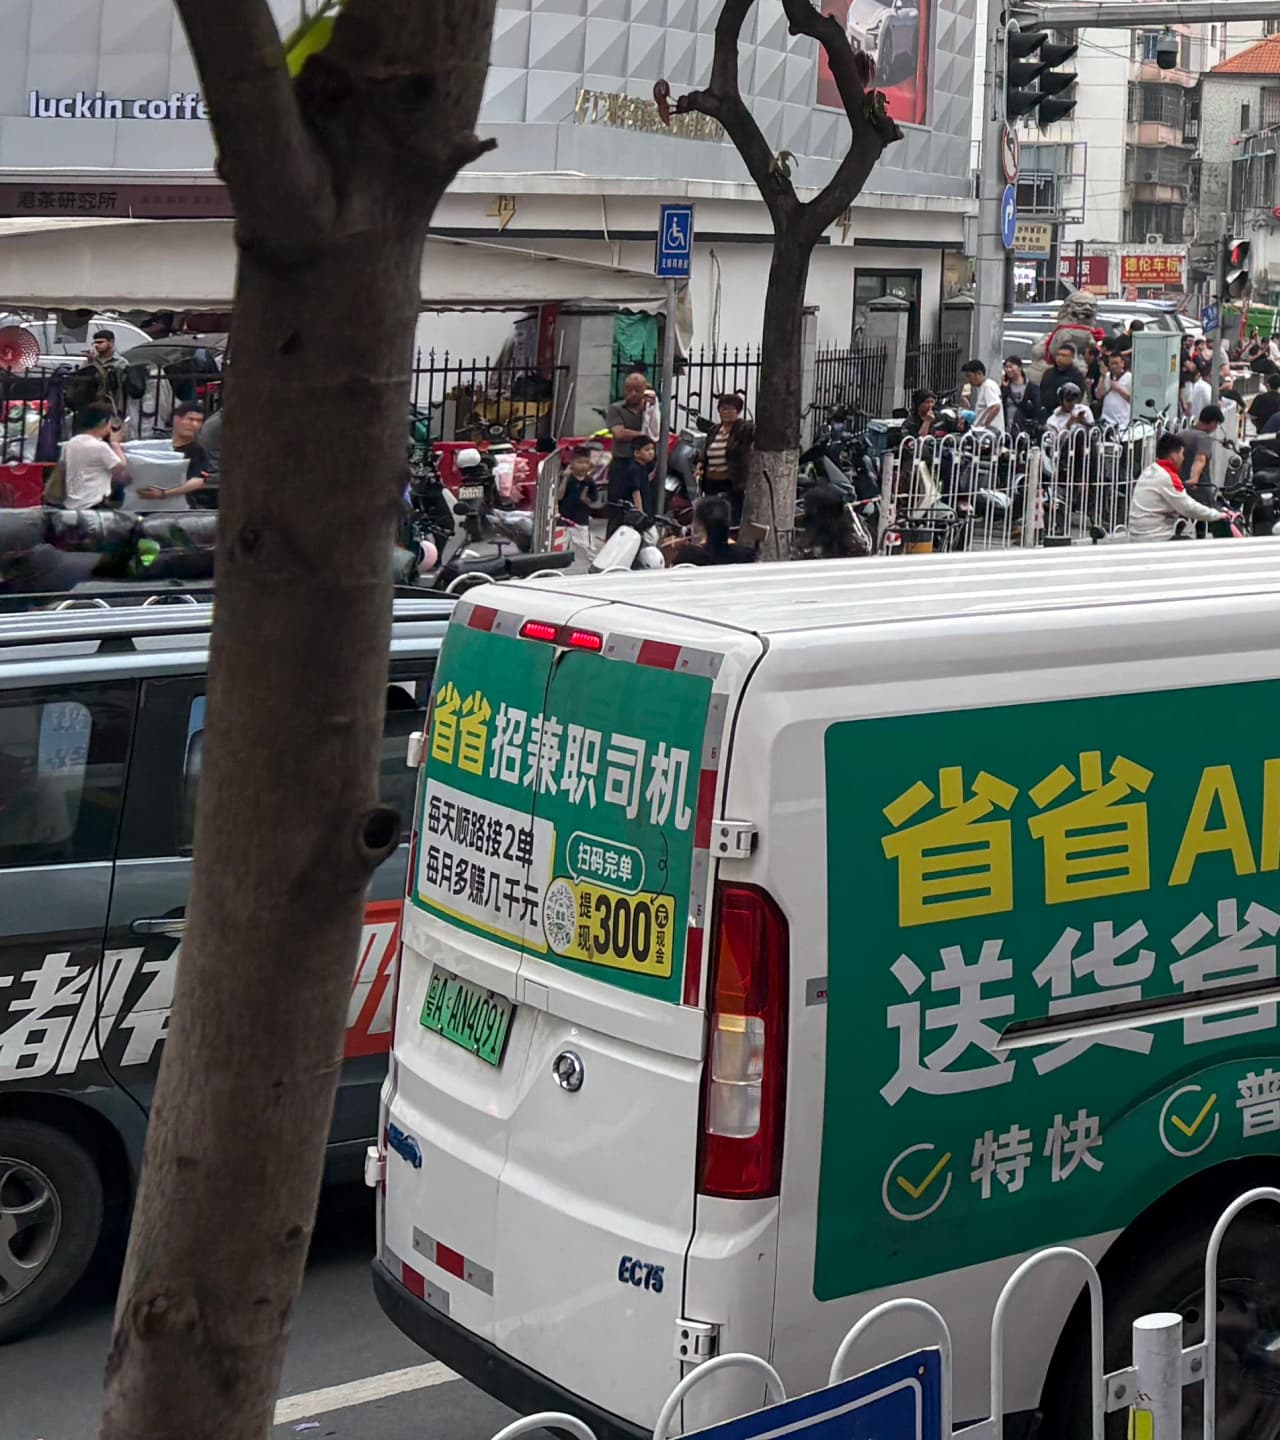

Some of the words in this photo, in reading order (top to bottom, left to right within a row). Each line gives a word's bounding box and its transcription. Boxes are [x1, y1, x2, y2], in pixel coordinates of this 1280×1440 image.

[29, 90, 123, 118] luckin
[133, 93, 210, 119] coffe
[427, 795, 535, 868] 每天顺路接2单
[577, 842, 633, 882] 扫码完单
[426, 845, 539, 927] 每月多赚几千元
[594, 894, 651, 962] 300
[971, 1110, 1104, 1199] 特快
[618, 1255, 664, 1293] EC75
